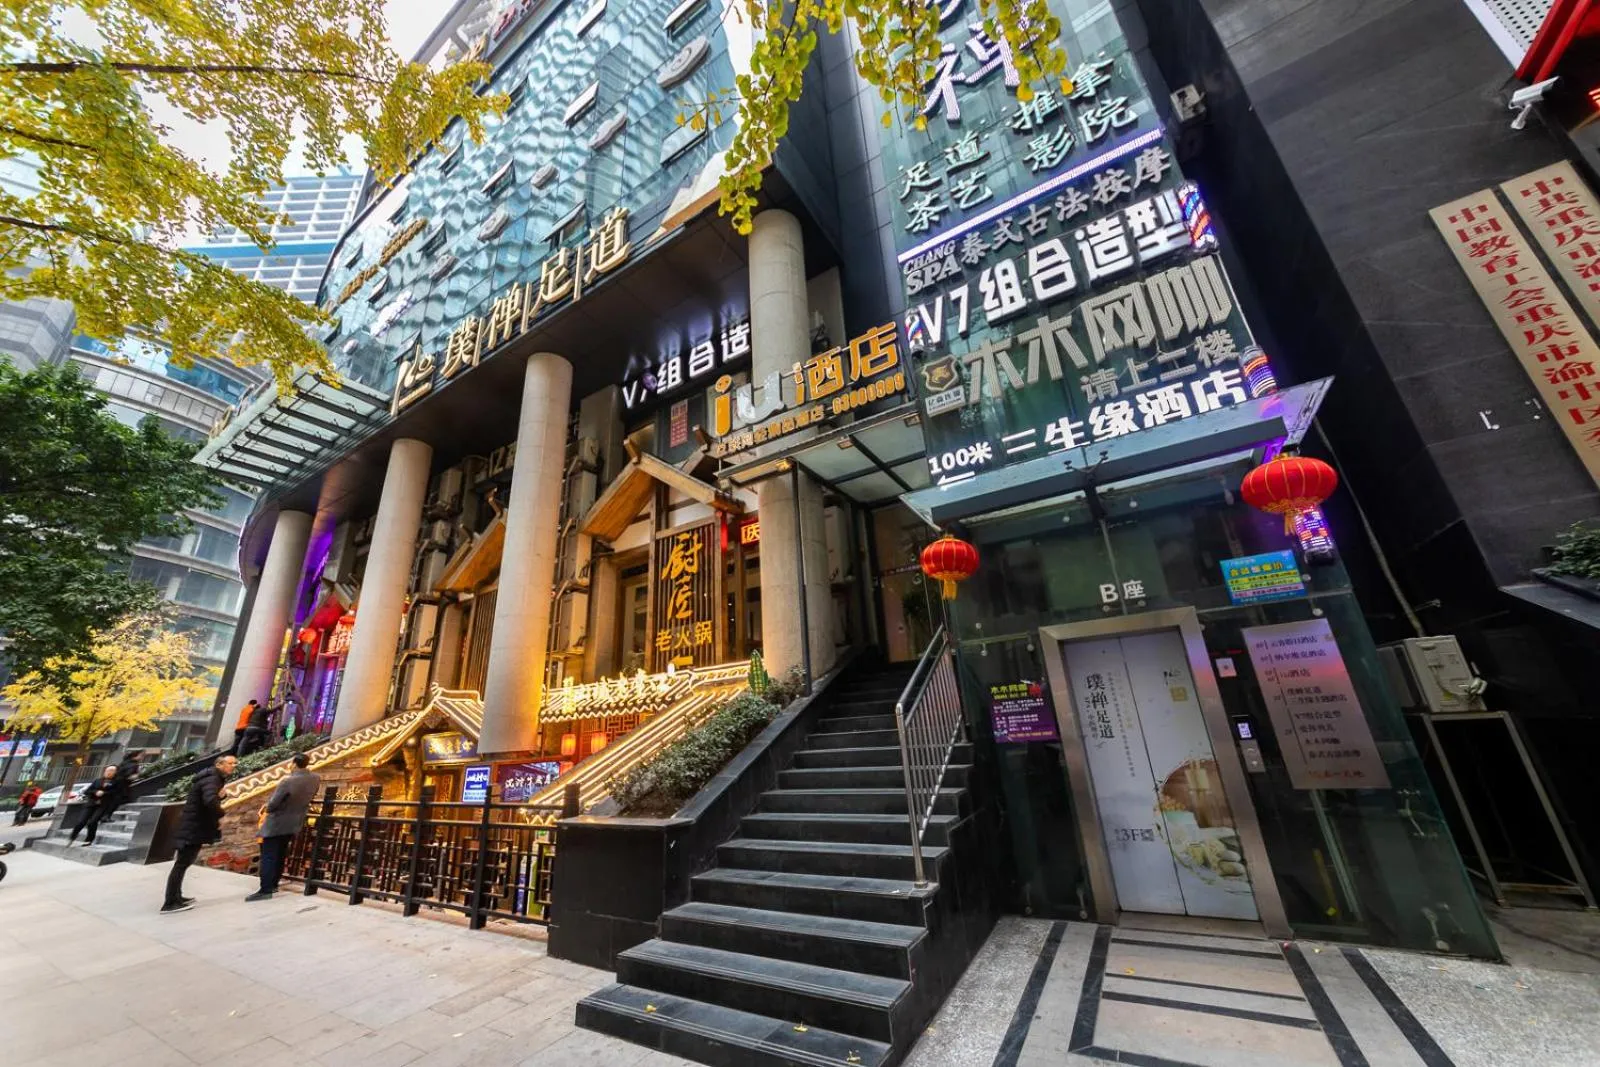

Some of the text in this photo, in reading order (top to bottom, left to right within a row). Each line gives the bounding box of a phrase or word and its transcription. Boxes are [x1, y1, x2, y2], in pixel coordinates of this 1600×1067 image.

[899, 54, 1115, 200] 足道 推拿
[904, 95, 1138, 233] 茶艺 影院
[960, 147, 1172, 264] 泰式古法按摩
[1519, 176, 1600, 292] 中共重庆市渝
[903, 240, 957, 275] CHANG
[906, 258, 962, 295] SPA
[917, 187, 1191, 344] V7组合造型
[962, 253, 1234, 405] 木木网咖
[1080, 328, 1240, 403] 请上二楼
[928, 441, 993, 474] 100米
[655, 620, 714, 652] 老火锅
[1099, 579, 1147, 604] B座
